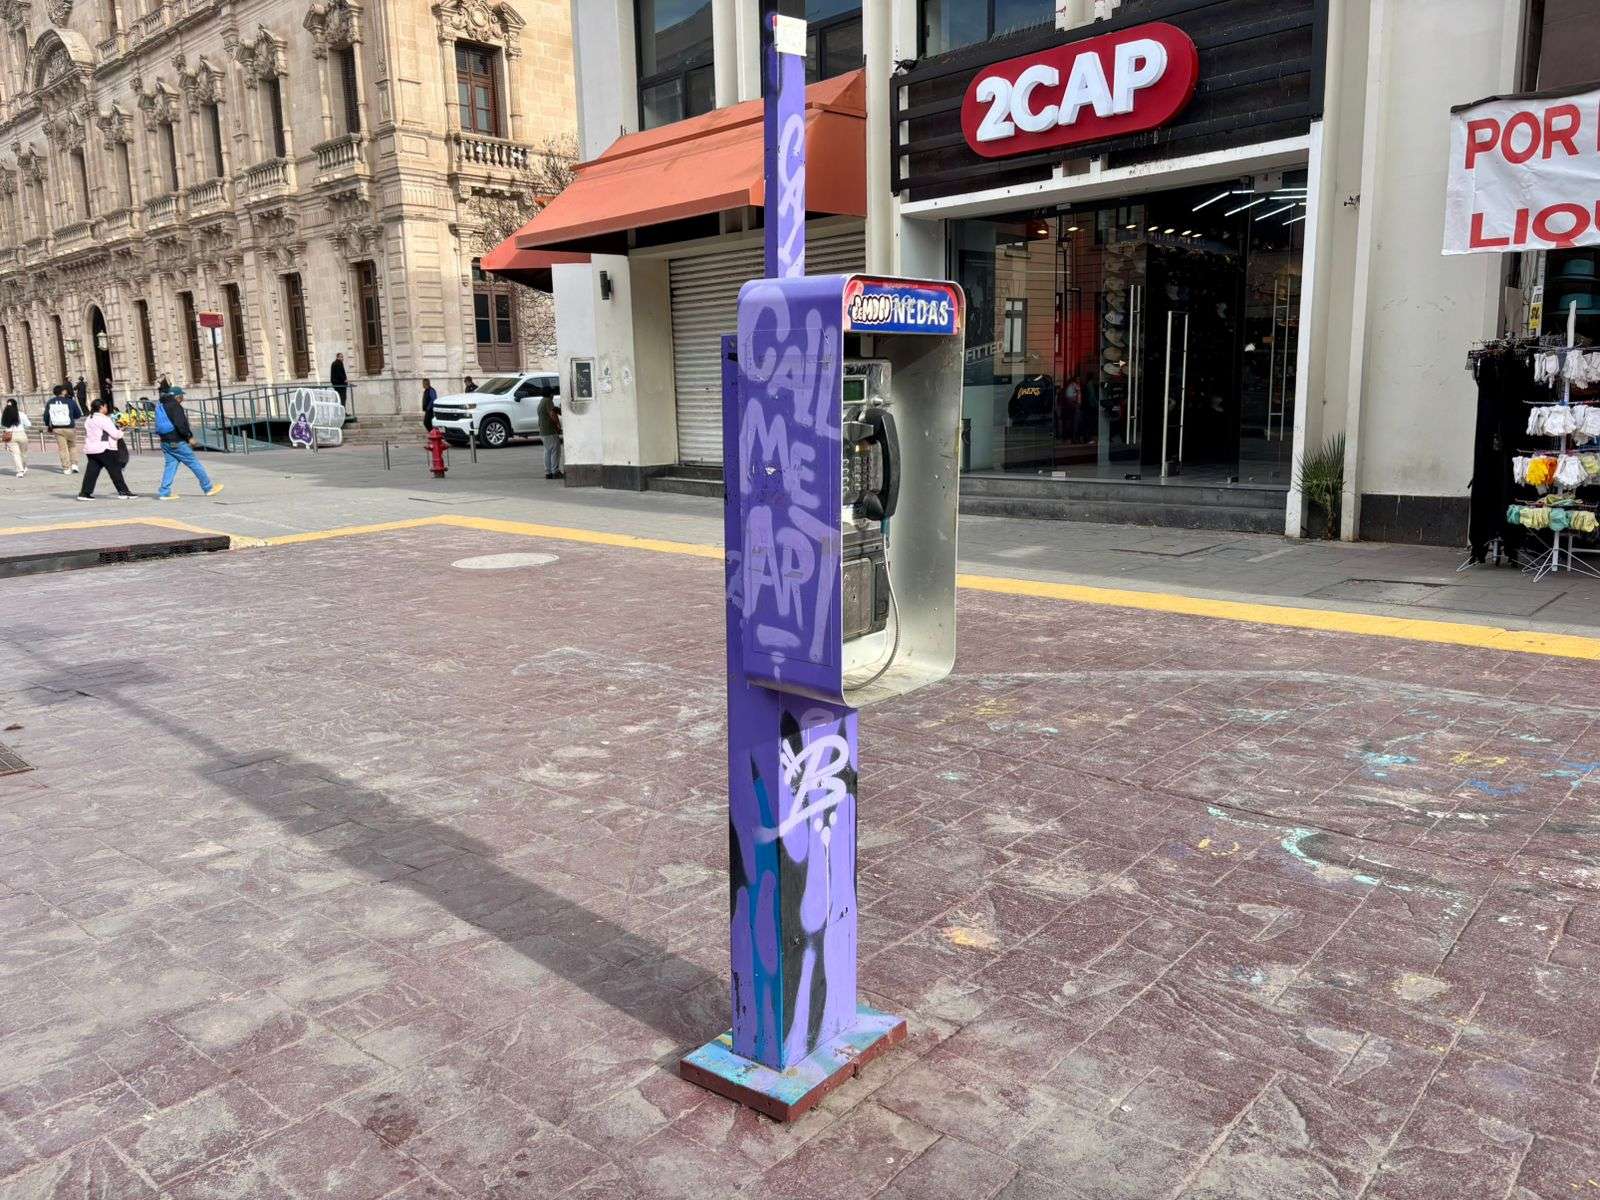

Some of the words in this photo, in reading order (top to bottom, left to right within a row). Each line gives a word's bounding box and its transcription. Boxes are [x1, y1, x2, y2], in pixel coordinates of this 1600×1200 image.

[976, 38, 1168, 143] 2CAP
[1465, 103, 1581, 169] POR
[1469, 200, 1600, 249] LIQ
